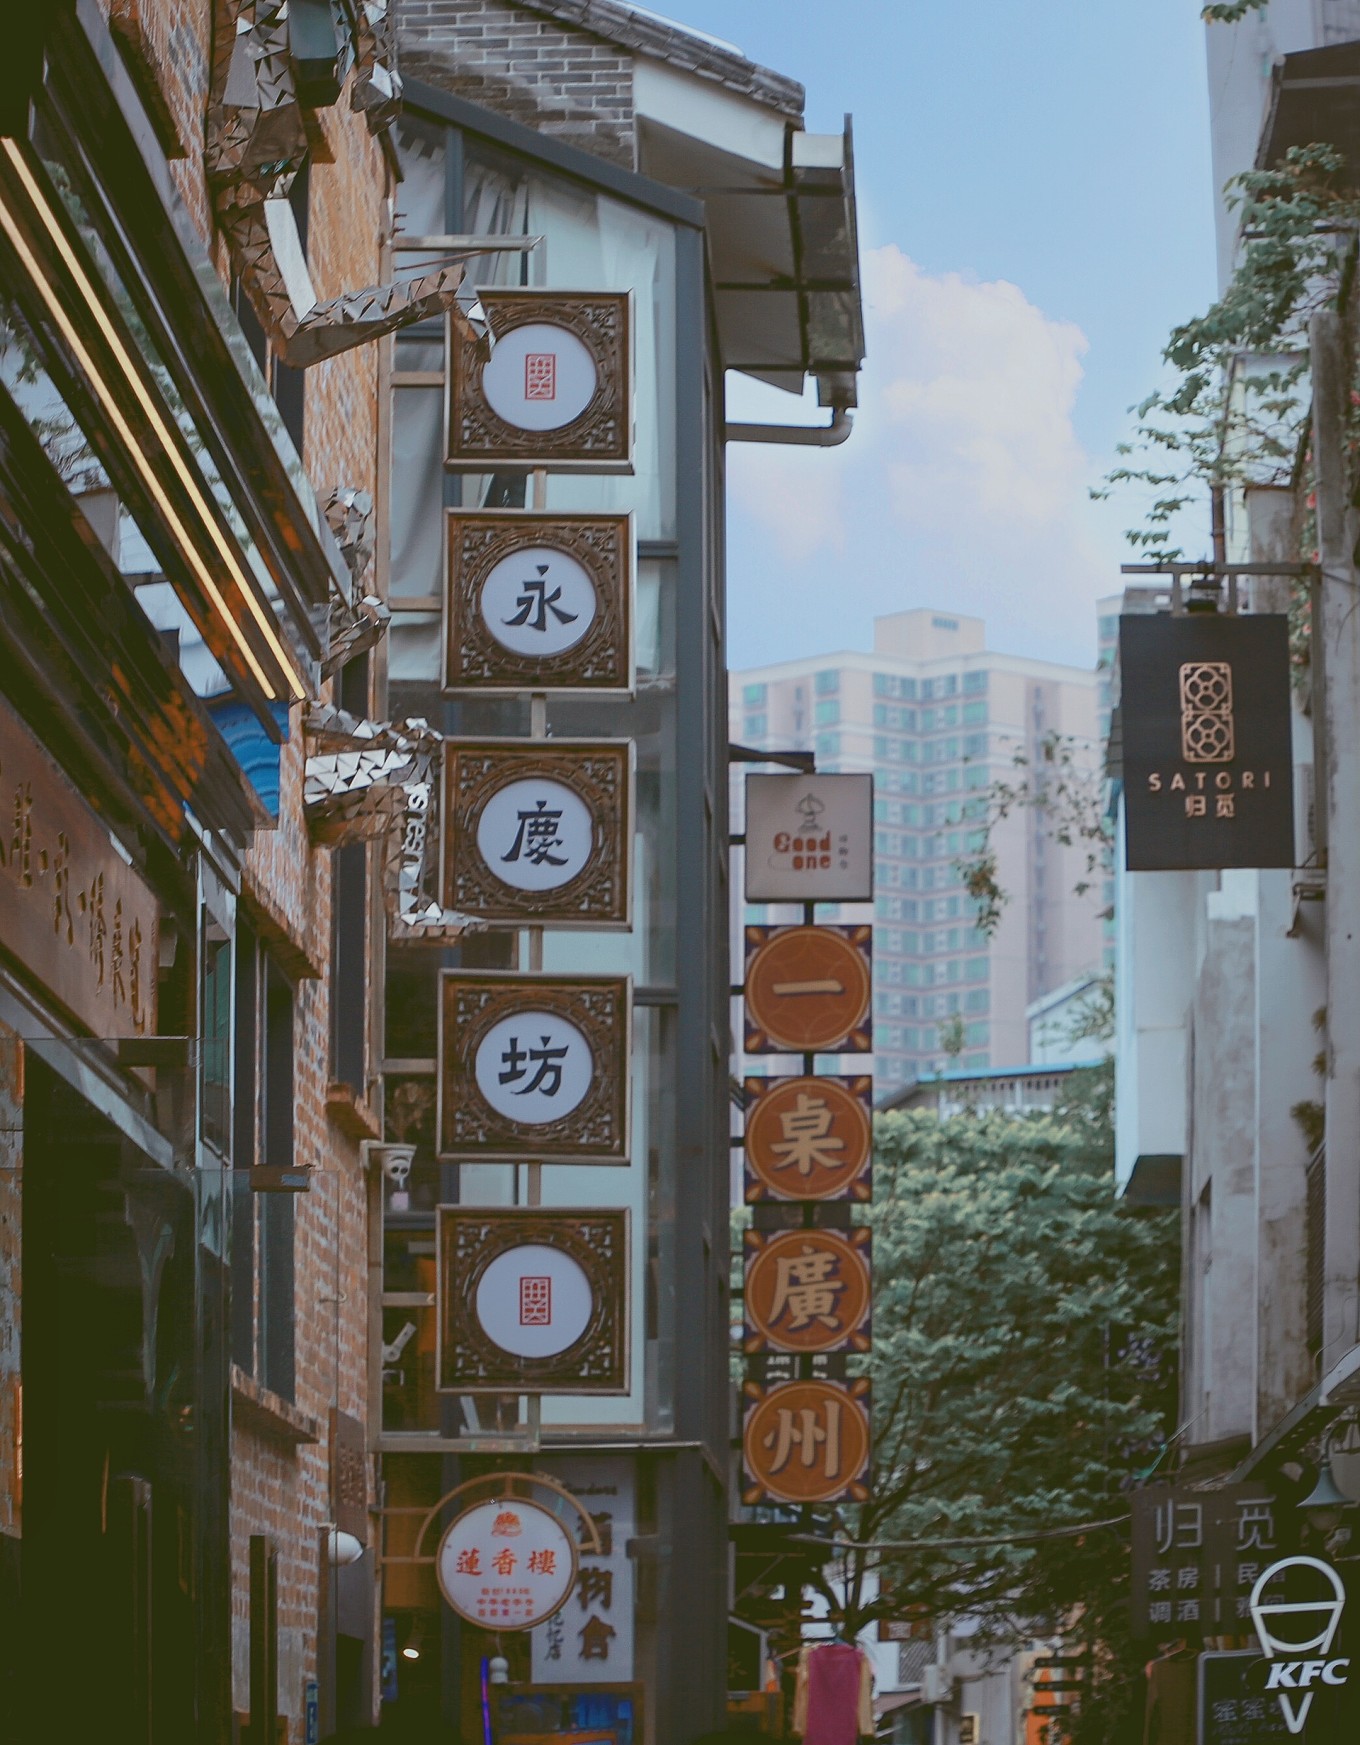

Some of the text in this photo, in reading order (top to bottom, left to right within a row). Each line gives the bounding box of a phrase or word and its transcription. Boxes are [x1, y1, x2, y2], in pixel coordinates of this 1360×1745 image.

[1148, 772, 1271, 794] SATORI
[773, 831, 832, 853] Good
[792, 855, 831, 871] one
[1264, 1659, 1351, 1689] KFC
